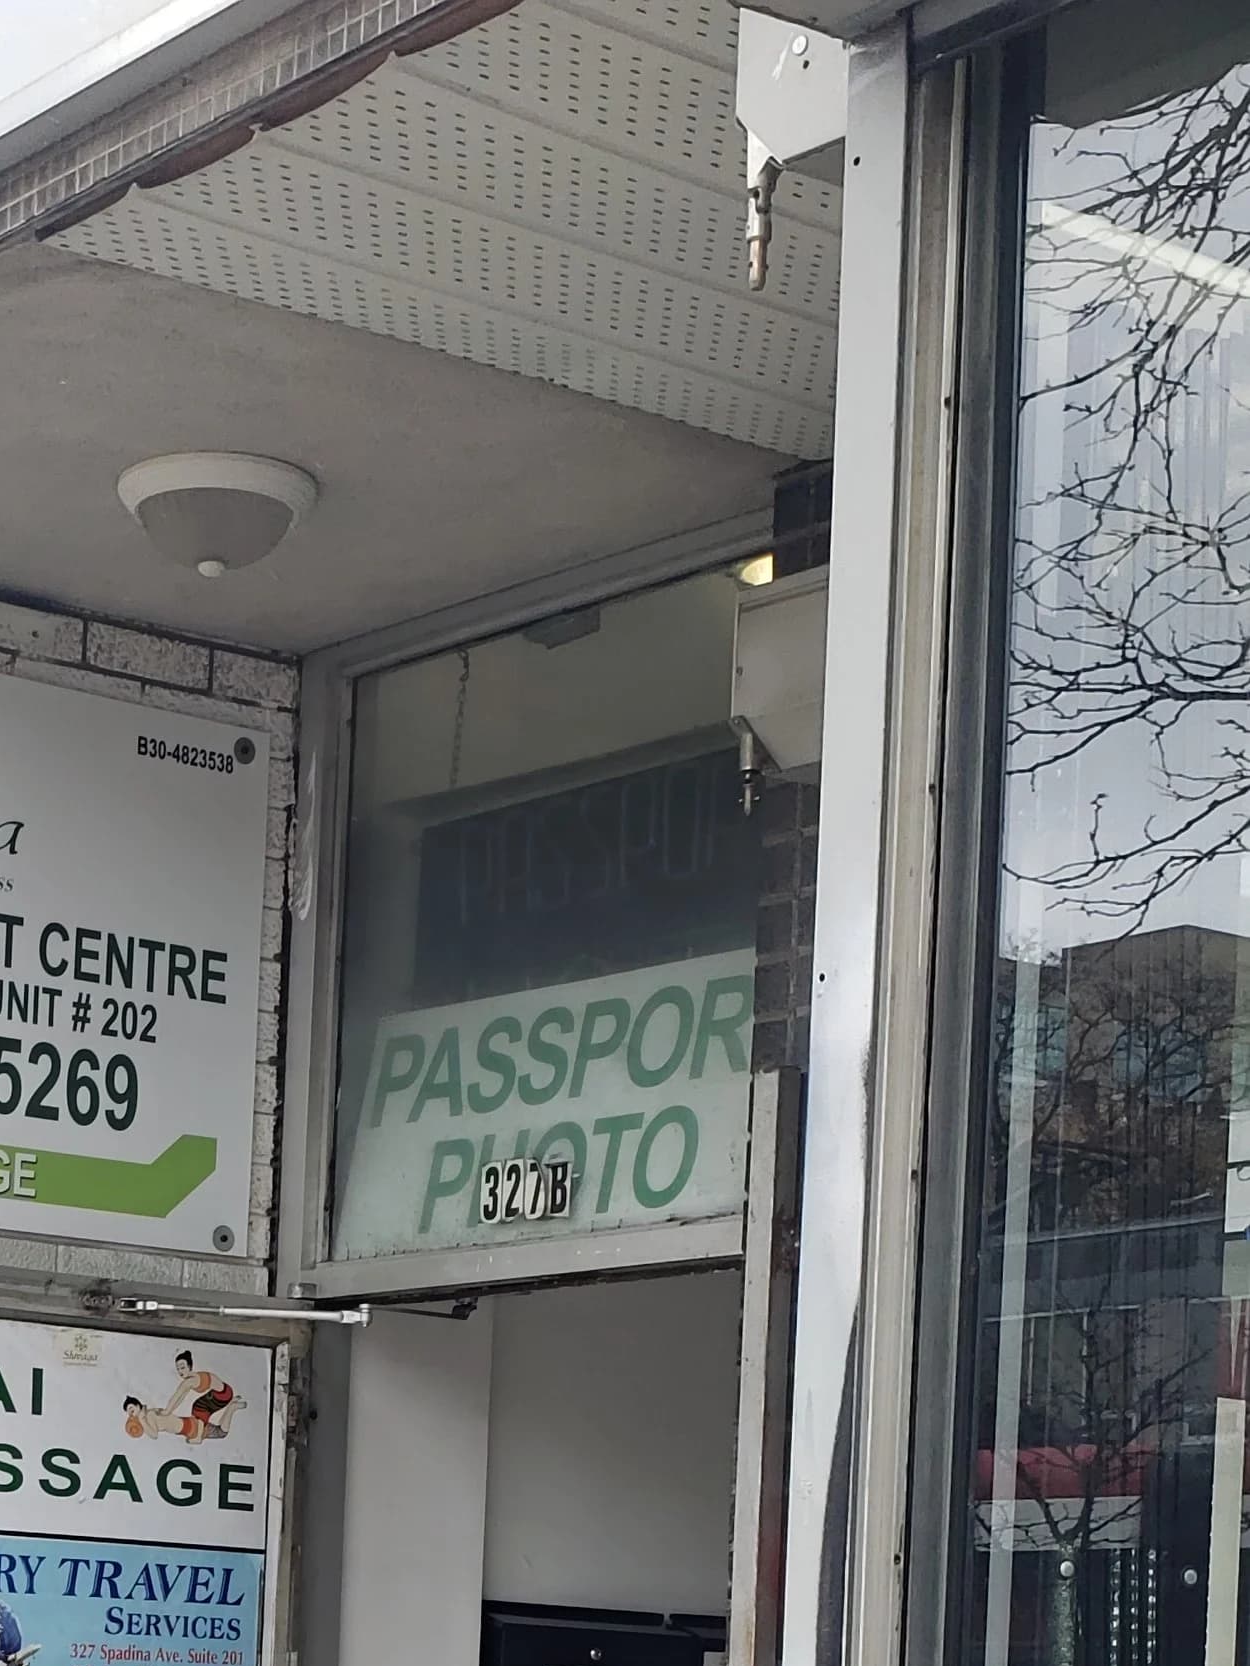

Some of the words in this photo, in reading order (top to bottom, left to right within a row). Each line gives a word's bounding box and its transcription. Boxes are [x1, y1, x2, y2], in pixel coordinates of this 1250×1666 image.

[137, 735, 235, 774] B30-4823538
[38, 921, 228, 1005] CENTRE
[70, 993, 93, 1033] #
[101, 996, 158, 1044] 202
[371, 973, 753, 1129] PASSPOR
[482, 1161, 569, 1221] 327B
[58, 1556, 245, 1607] TRAVEL
[103, 1606, 242, 1641] SERVICES
[69, 1643, 96, 1661] 327
[99, 1644, 150, 1666] Spadina
[154, 1647, 184, 1664] Ave.
[187, 1648, 216, 1665] Suite
[220, 1651, 243, 1666] 201
